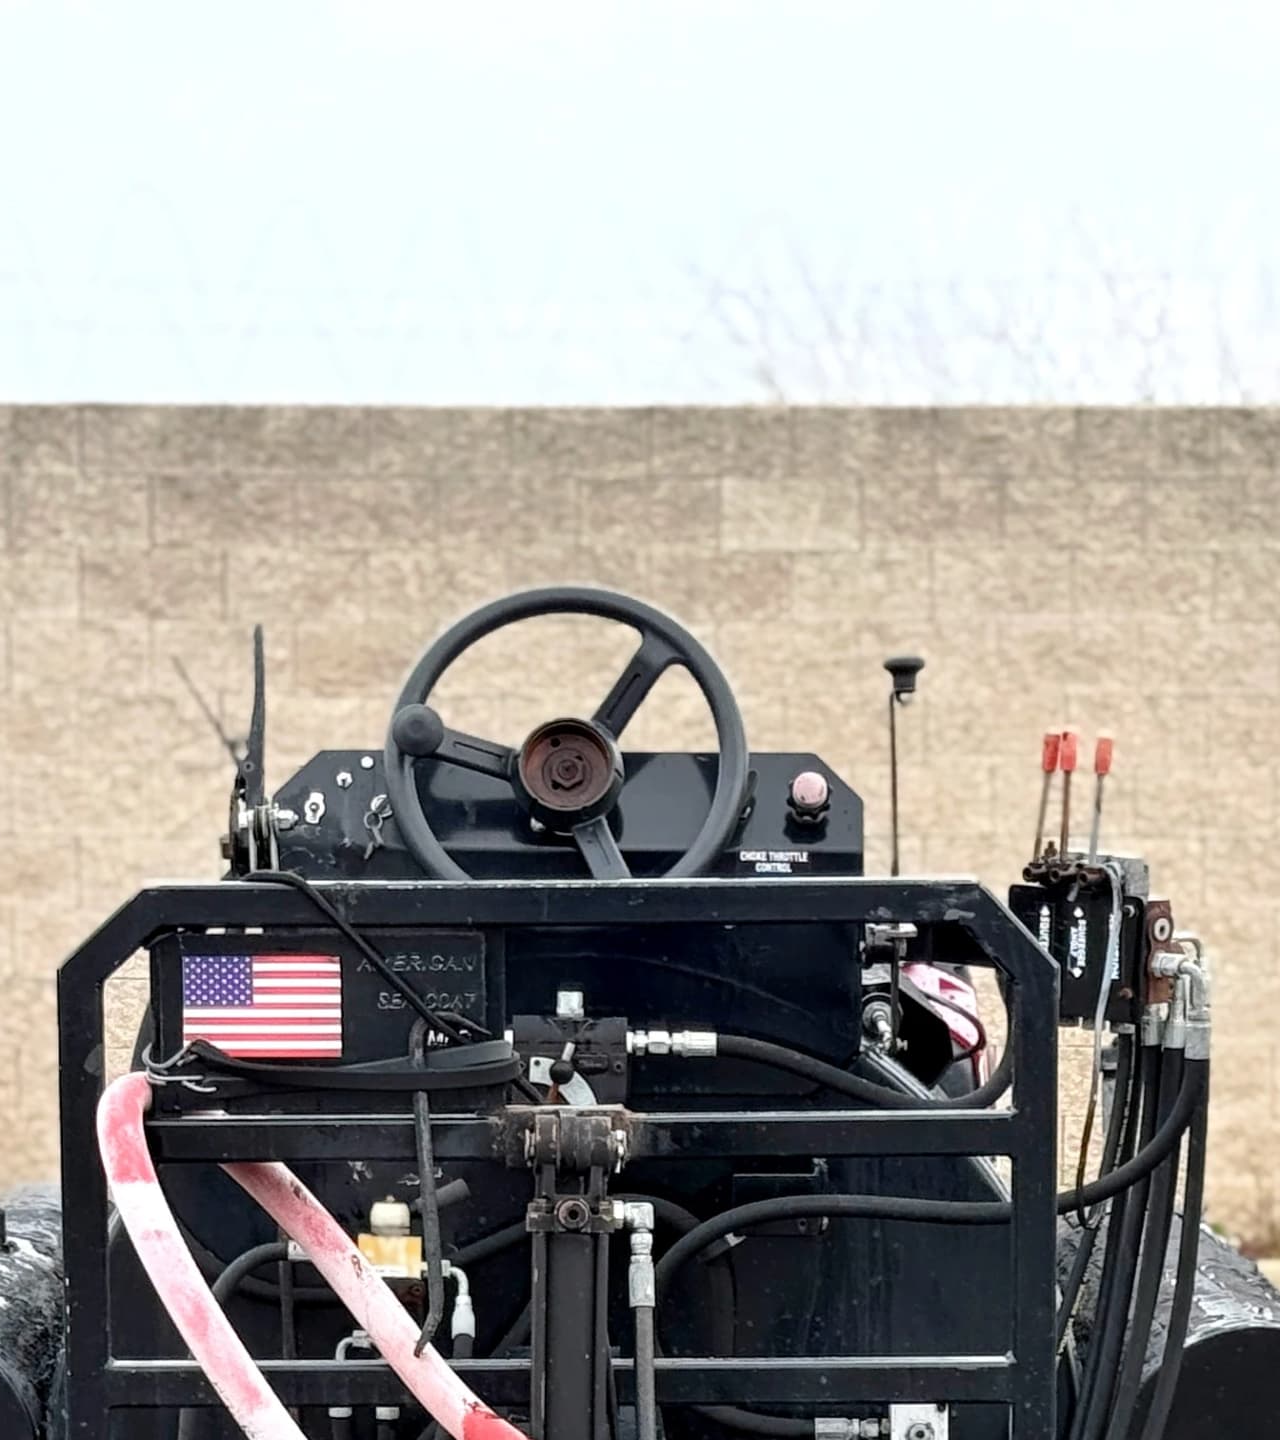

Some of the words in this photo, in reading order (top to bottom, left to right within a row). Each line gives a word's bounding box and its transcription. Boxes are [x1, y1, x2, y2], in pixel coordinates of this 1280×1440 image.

[768, 850, 808, 863] THROTTLE
[755, 862, 793, 873] CONTROL
[356, 954, 477, 973] AERICAN
